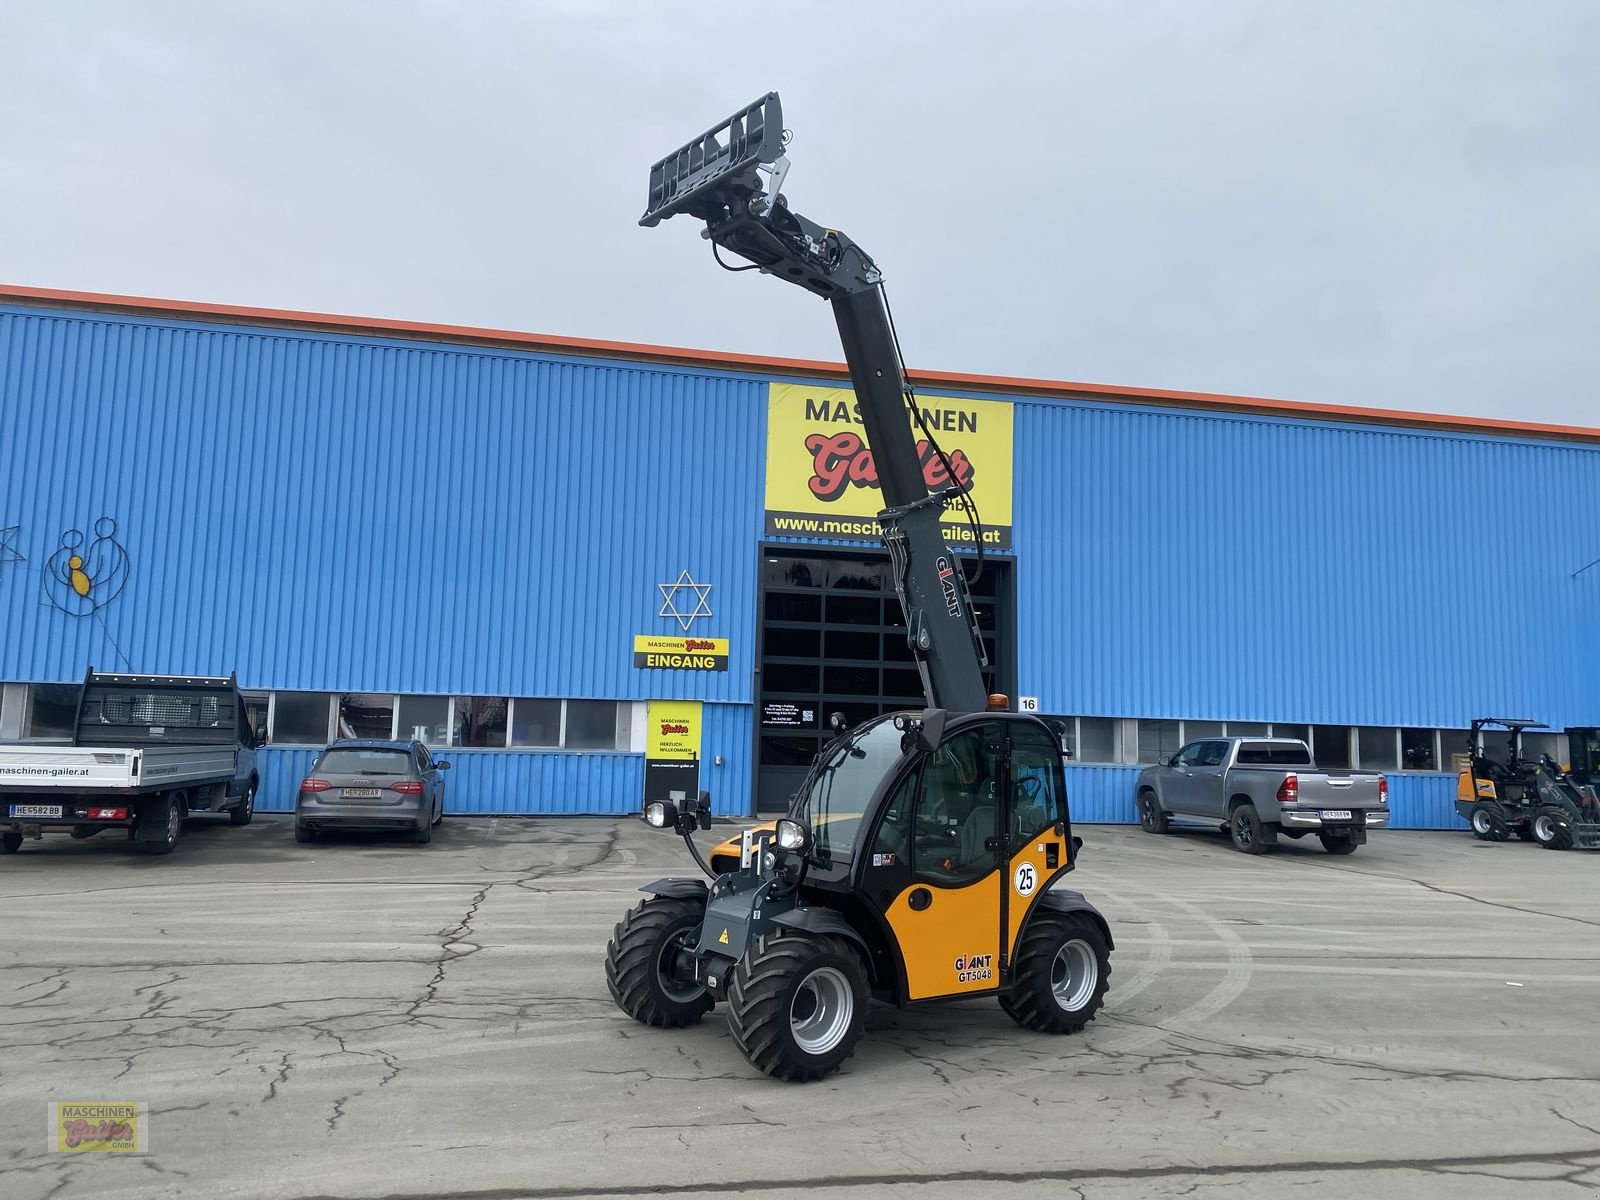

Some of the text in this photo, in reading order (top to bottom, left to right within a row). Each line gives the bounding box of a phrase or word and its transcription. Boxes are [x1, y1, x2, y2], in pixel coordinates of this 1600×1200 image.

[647, 654, 715, 668] EINGANG
[1022, 699, 1035, 709] 16
[1020, 868, 1033, 890] 25
[959, 969, 992, 982] GT5048
